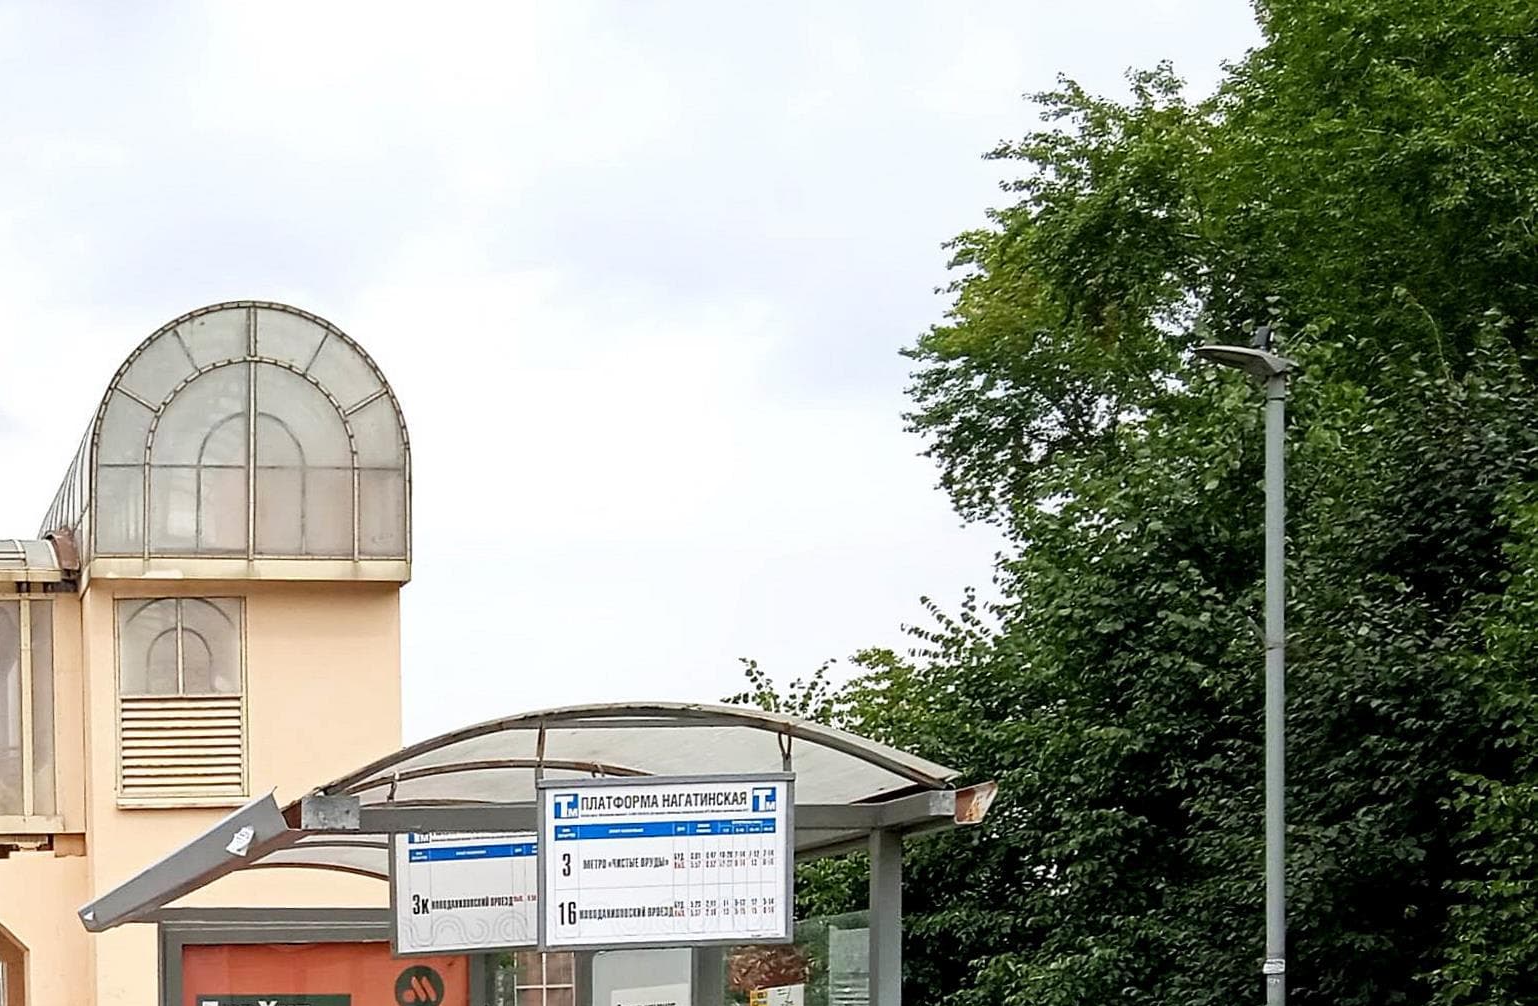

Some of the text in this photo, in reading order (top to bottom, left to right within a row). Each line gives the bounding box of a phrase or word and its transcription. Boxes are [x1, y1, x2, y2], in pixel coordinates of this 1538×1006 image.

[581, 791, 747, 810] ПЛАТФОРМА НАГАТИНСКАЯ
[562, 853, 571, 876] 3
[558, 902, 577, 925] 16
